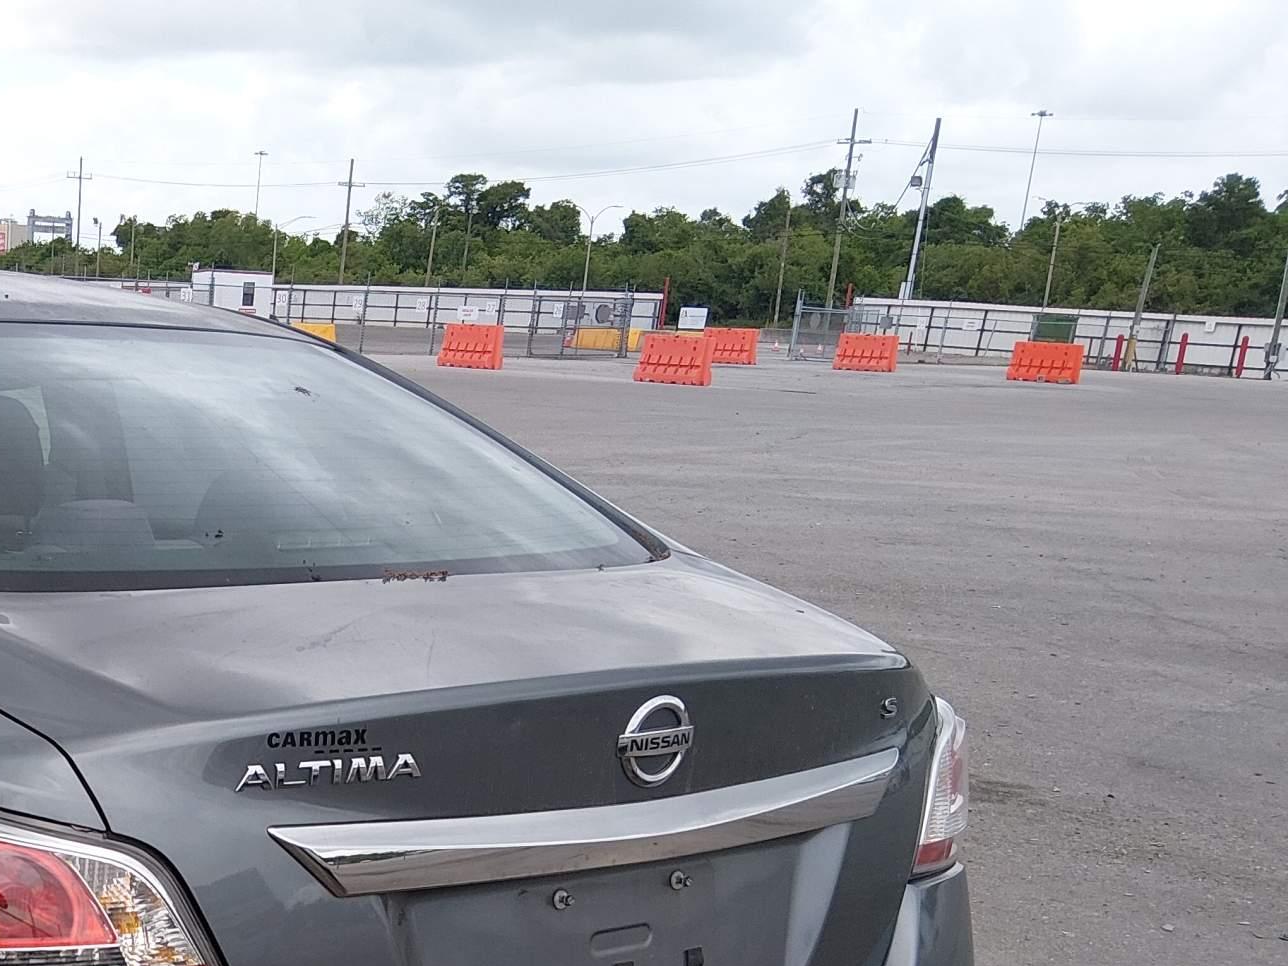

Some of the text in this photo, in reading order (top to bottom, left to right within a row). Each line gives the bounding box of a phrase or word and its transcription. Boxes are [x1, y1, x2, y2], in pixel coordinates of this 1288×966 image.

[277, 293, 288, 304] 30
[880, 697, 898, 719] S
[630, 731, 691, 752] NISSAN
[235, 753, 422, 793] ALTIMA
